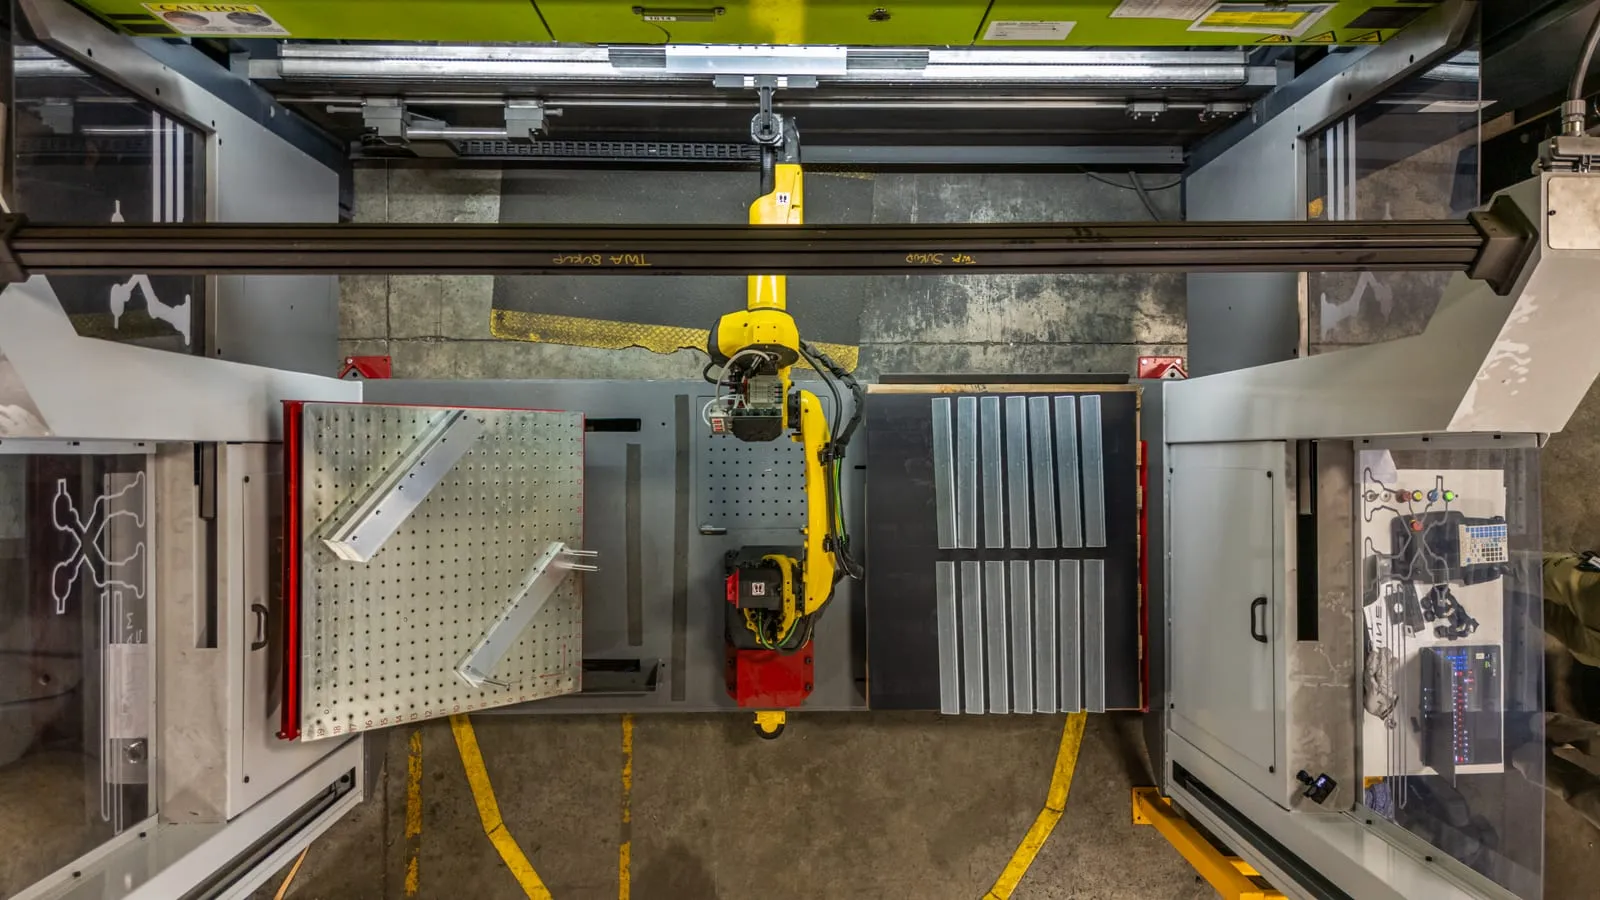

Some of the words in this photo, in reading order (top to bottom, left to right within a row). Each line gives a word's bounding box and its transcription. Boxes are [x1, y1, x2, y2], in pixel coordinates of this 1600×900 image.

[159, 4, 249, 12] CAUTION
[608, 253, 653, 267] TWA
[410, 712, 418, 720] 13
[425, 709, 432, 718] 12
[380, 717, 388, 726] 15
[395, 714, 402, 723] 14
[364, 719, 373, 728] 16
[332, 725, 341, 734] 18
